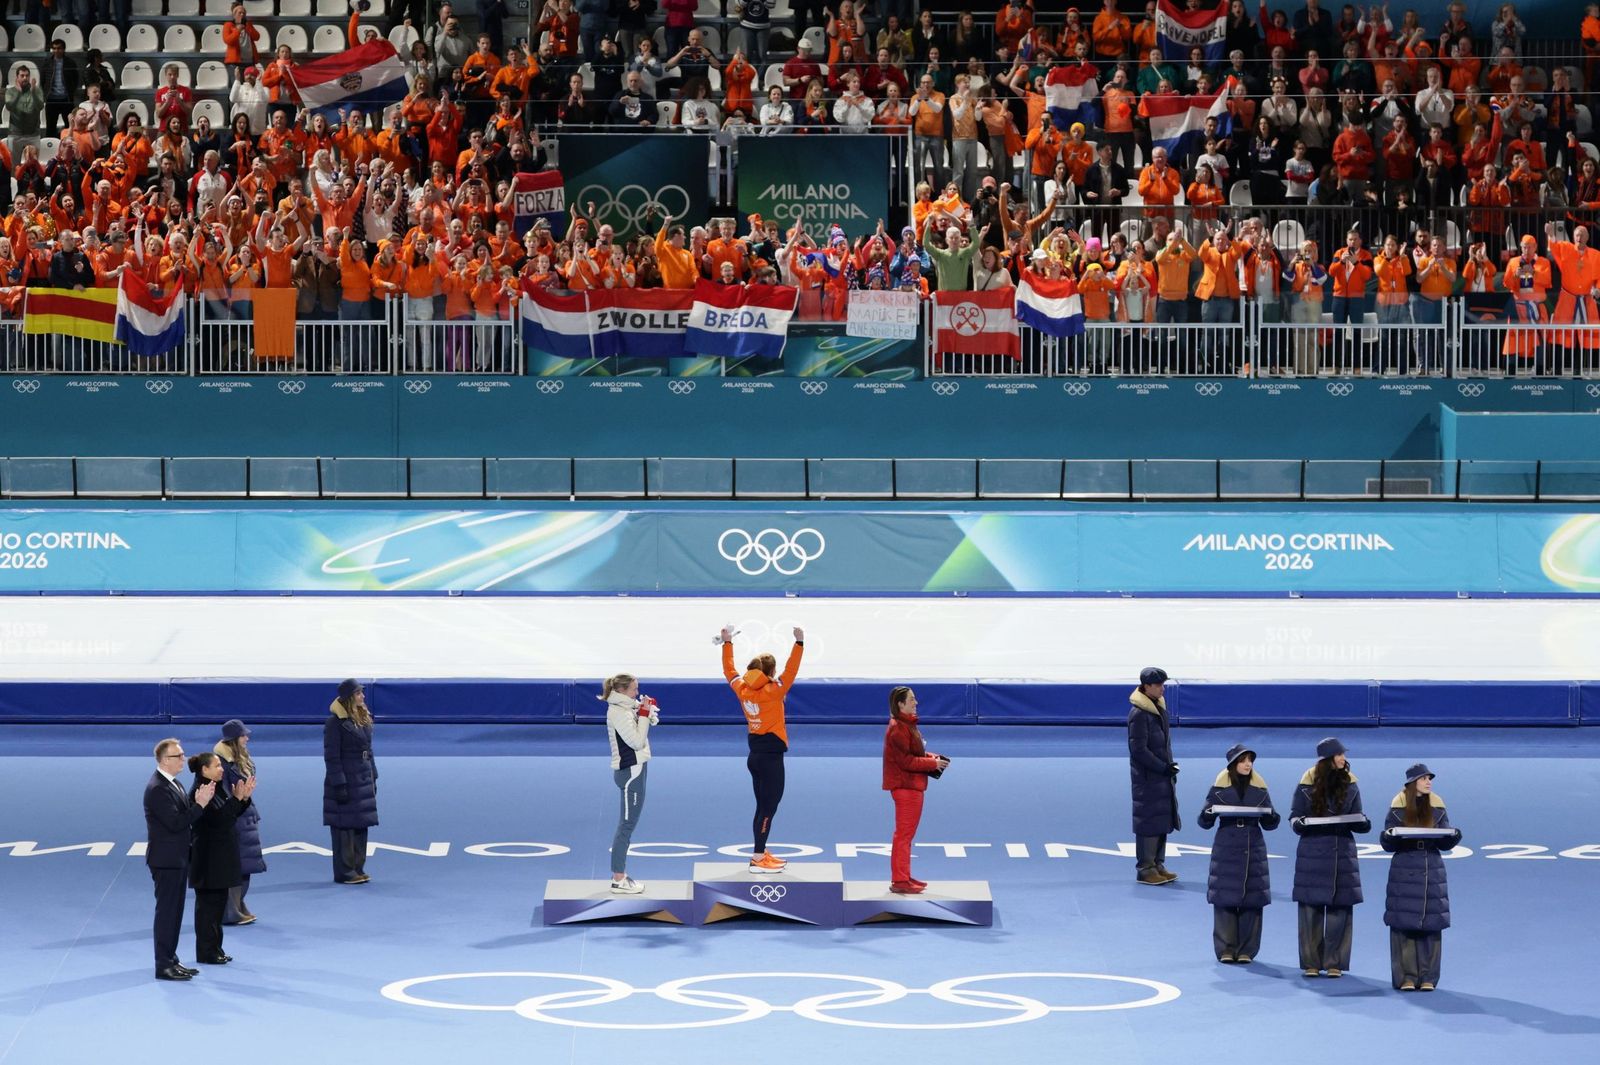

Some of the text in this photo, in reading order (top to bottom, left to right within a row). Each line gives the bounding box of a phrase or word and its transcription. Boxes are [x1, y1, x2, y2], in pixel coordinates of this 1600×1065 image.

[757, 184, 850, 200] MILANO
[516, 189, 564, 214] FORZA
[774, 203, 869, 219] CORTINA
[598, 310, 689, 330] ZWOLLE
[704, 309, 769, 329] BREDA
[26, 532, 131, 550] CORTINA
[1183, 534, 1394, 550] MILANO CORTINA
[0, 552, 48, 568] 2026
[1265, 553, 1313, 570] 2026
[0, 842, 570, 857] MIANO
